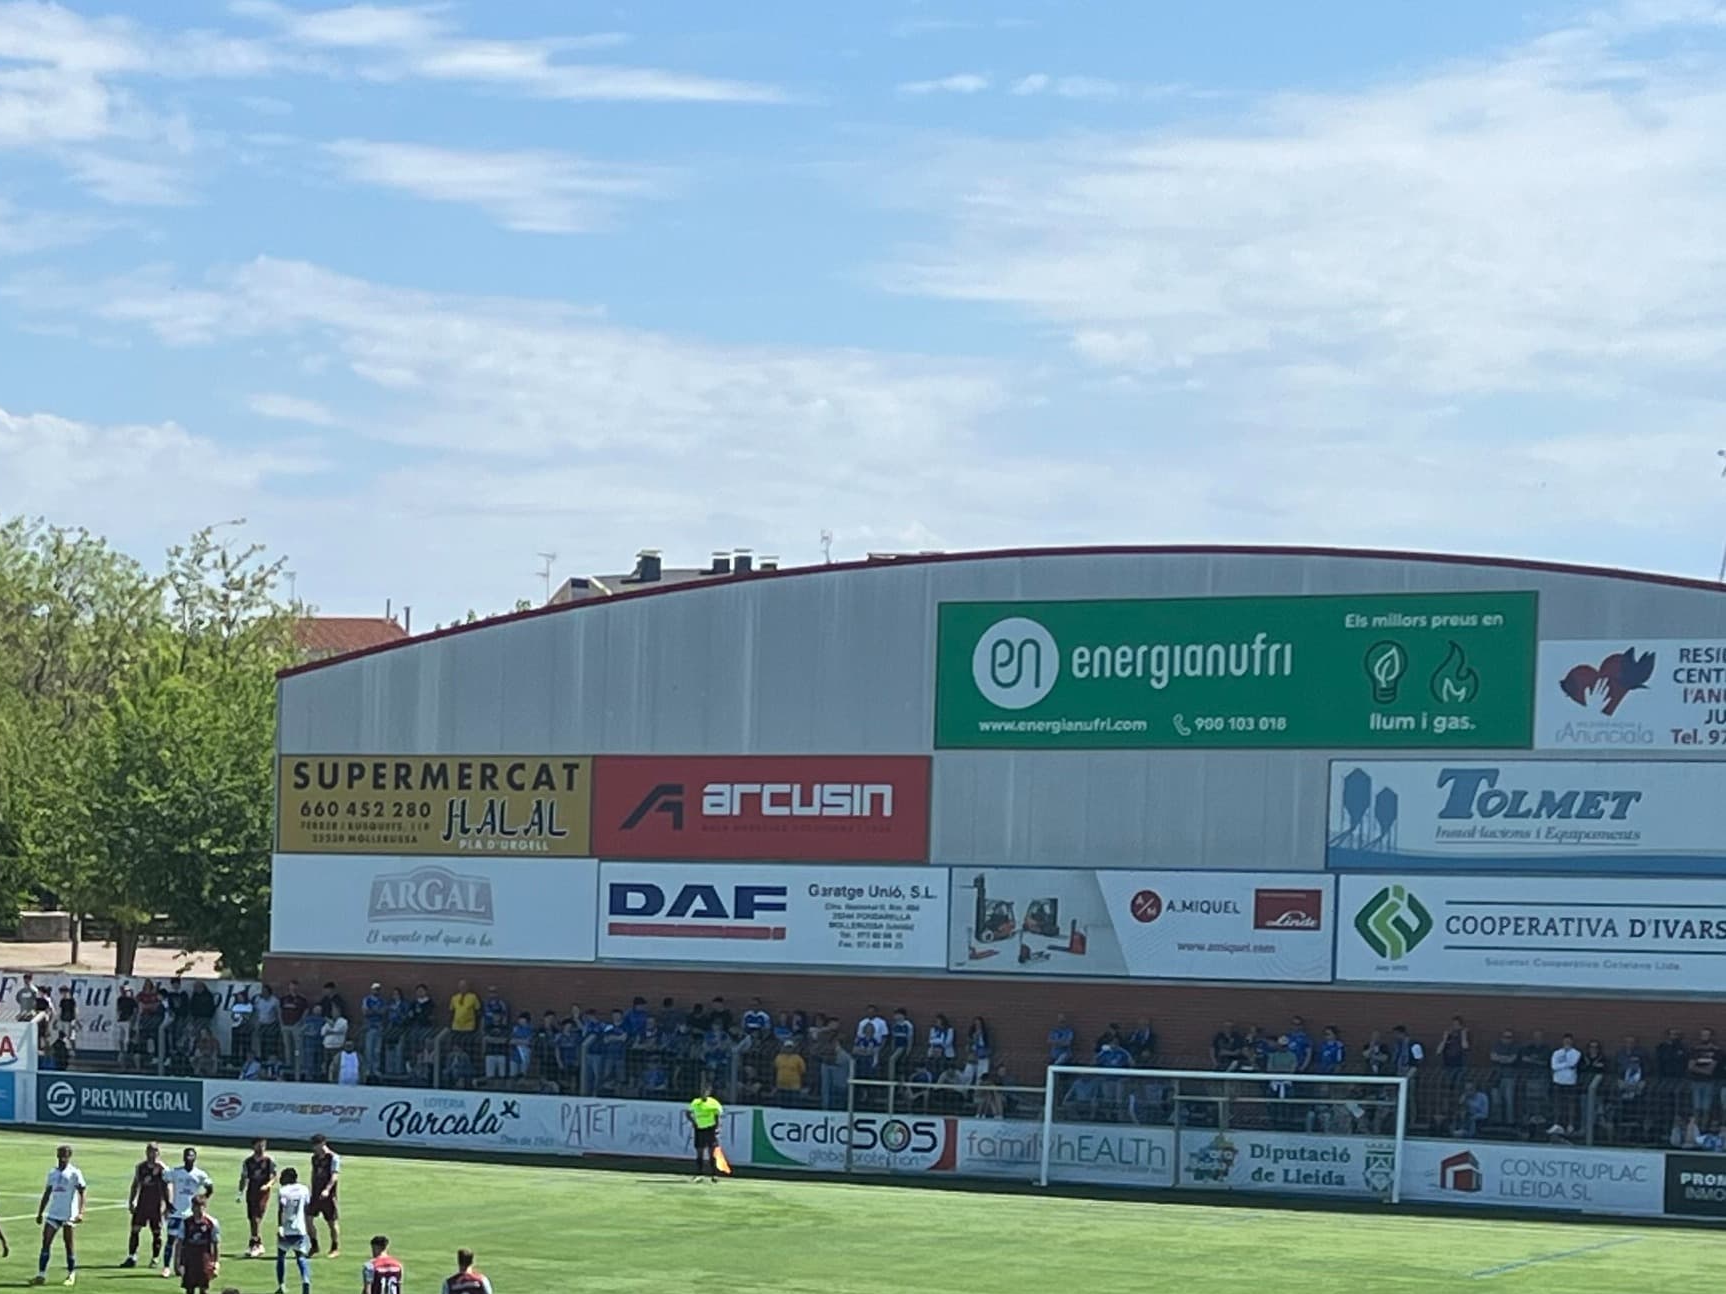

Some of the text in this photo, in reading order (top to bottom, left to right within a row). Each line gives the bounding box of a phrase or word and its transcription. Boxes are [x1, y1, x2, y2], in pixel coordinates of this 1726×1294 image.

[1372, 612, 1427, 628] millors
[1431, 614, 1477, 631] preus
[1481, 614, 1504, 627] en
[1071, 632, 1292, 690] energianufri
[1672, 667, 1726, 684] CENT
[978, 717, 1148, 735] www.energianufri.com
[1194, 716, 1287, 731] 900 103 018
[1370, 712, 1415, 730] llum
[1432, 714, 1476, 733] gas.
[1670, 728, 1704, 745] Tel.
[292, 761, 580, 791] SUPERMERCAT
[300, 801, 431, 818] 660 452 280
[701, 782, 894, 817] arcusin
[442, 797, 568, 842] HALAL
[375, 878, 486, 913] ARGAL
[609, 883, 788, 920] DAF
[808, 883, 865, 901] Garatge
[1445, 914, 1619, 939] COOPERATIVA
[80, 1087, 192, 1112] PREVINTEGRAL
[379, 1097, 504, 1139] Barcala
[1250, 1142, 1352, 1166] Diputació
[1251, 1167, 1346, 1188] de Lleida
[1500, 1158, 1648, 1183] CONSTRUPLAC
[1499, 1178, 1592, 1201] LLEIDA SL
